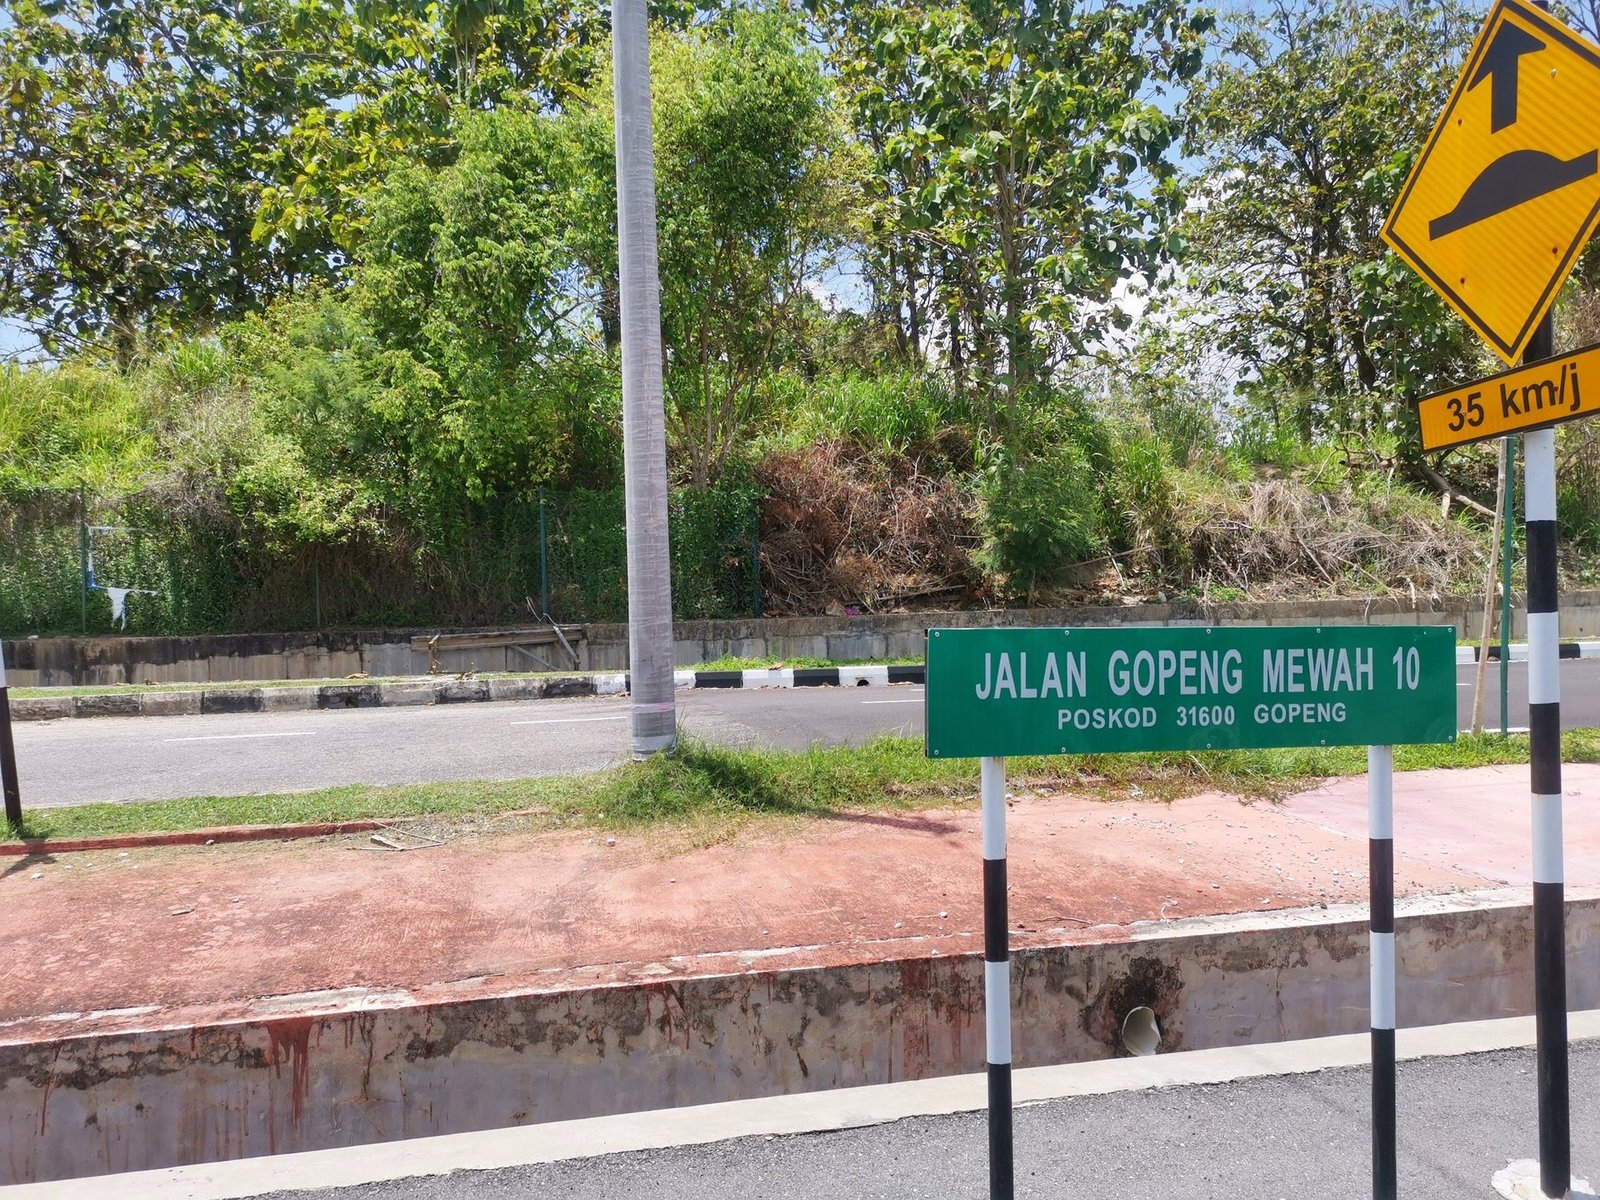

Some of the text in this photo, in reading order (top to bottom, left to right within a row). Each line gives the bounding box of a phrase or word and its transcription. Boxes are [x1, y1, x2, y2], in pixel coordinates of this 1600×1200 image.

[1447, 362, 1581, 432] 35 km/j
[975, 647, 1420, 700] JALAN GOPENG MEWAH 10
[1057, 702, 1347, 730] POSKOD 31600 GOPENG
